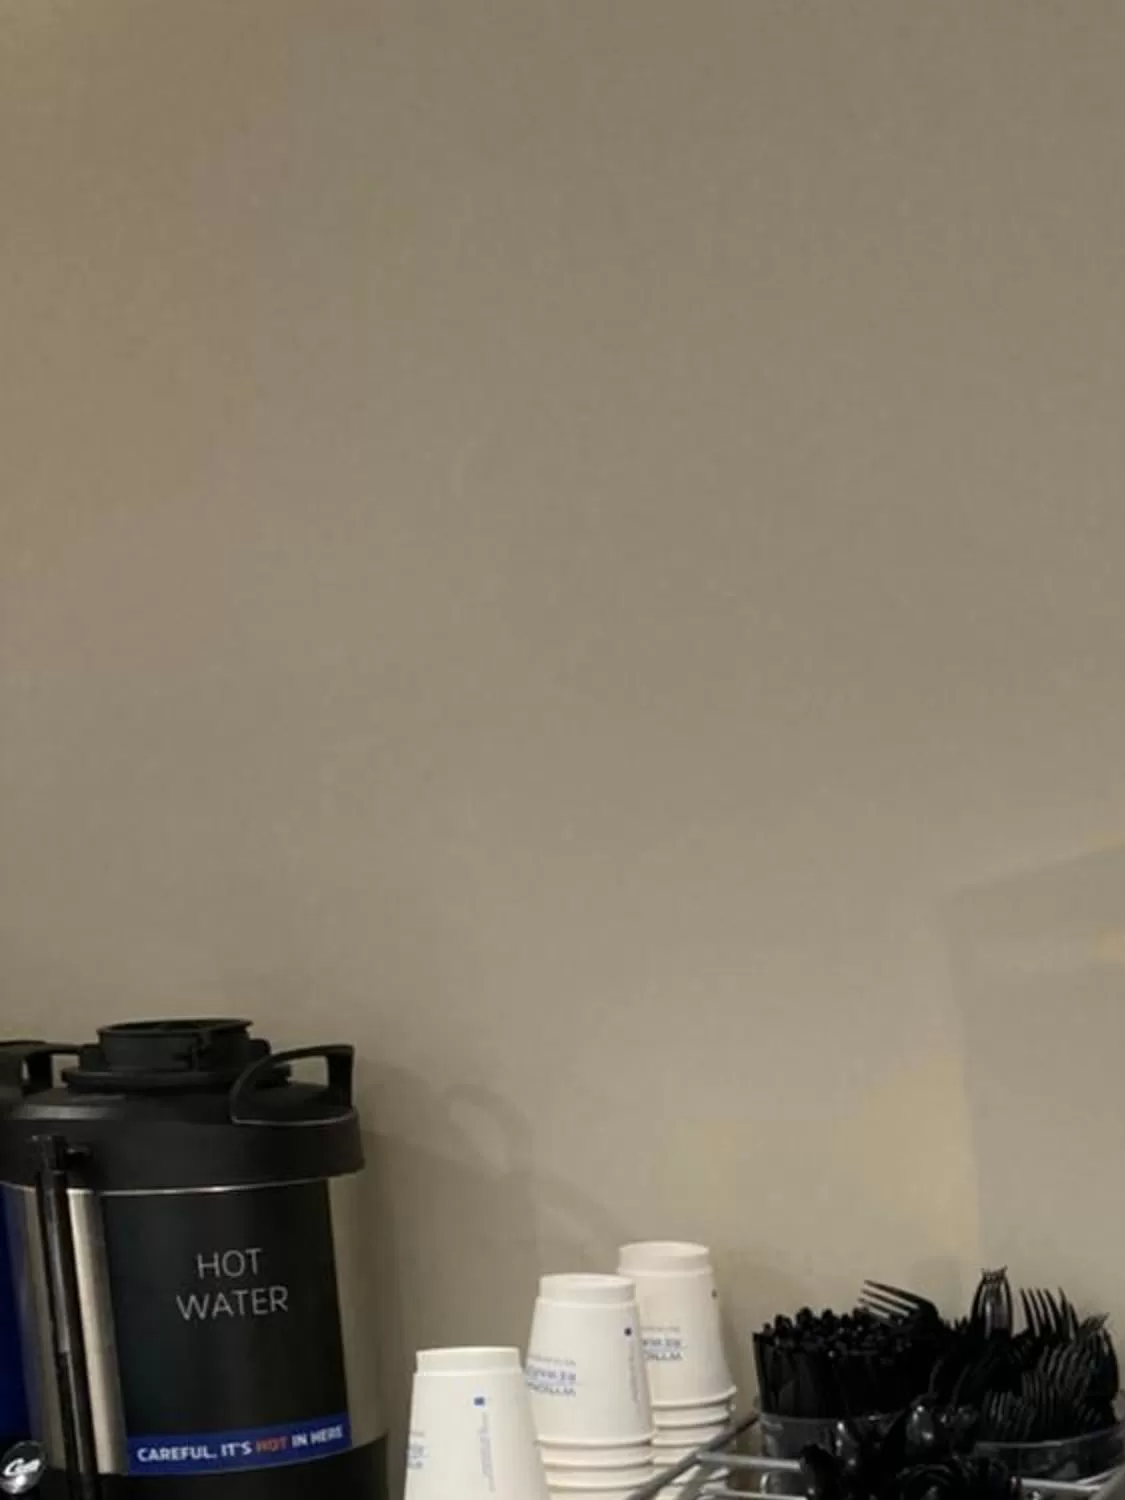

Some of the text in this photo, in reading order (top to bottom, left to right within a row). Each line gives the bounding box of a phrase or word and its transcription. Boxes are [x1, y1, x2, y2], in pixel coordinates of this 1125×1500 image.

[196, 1247, 262, 1279] HOT
[175, 1285, 289, 1321] WATER
[221, 1440, 253, 1457] IT'S
[255, 1435, 288, 1453] HOT
[291, 1431, 309, 1448] IN
[310, 1423, 344, 1444] HERE
